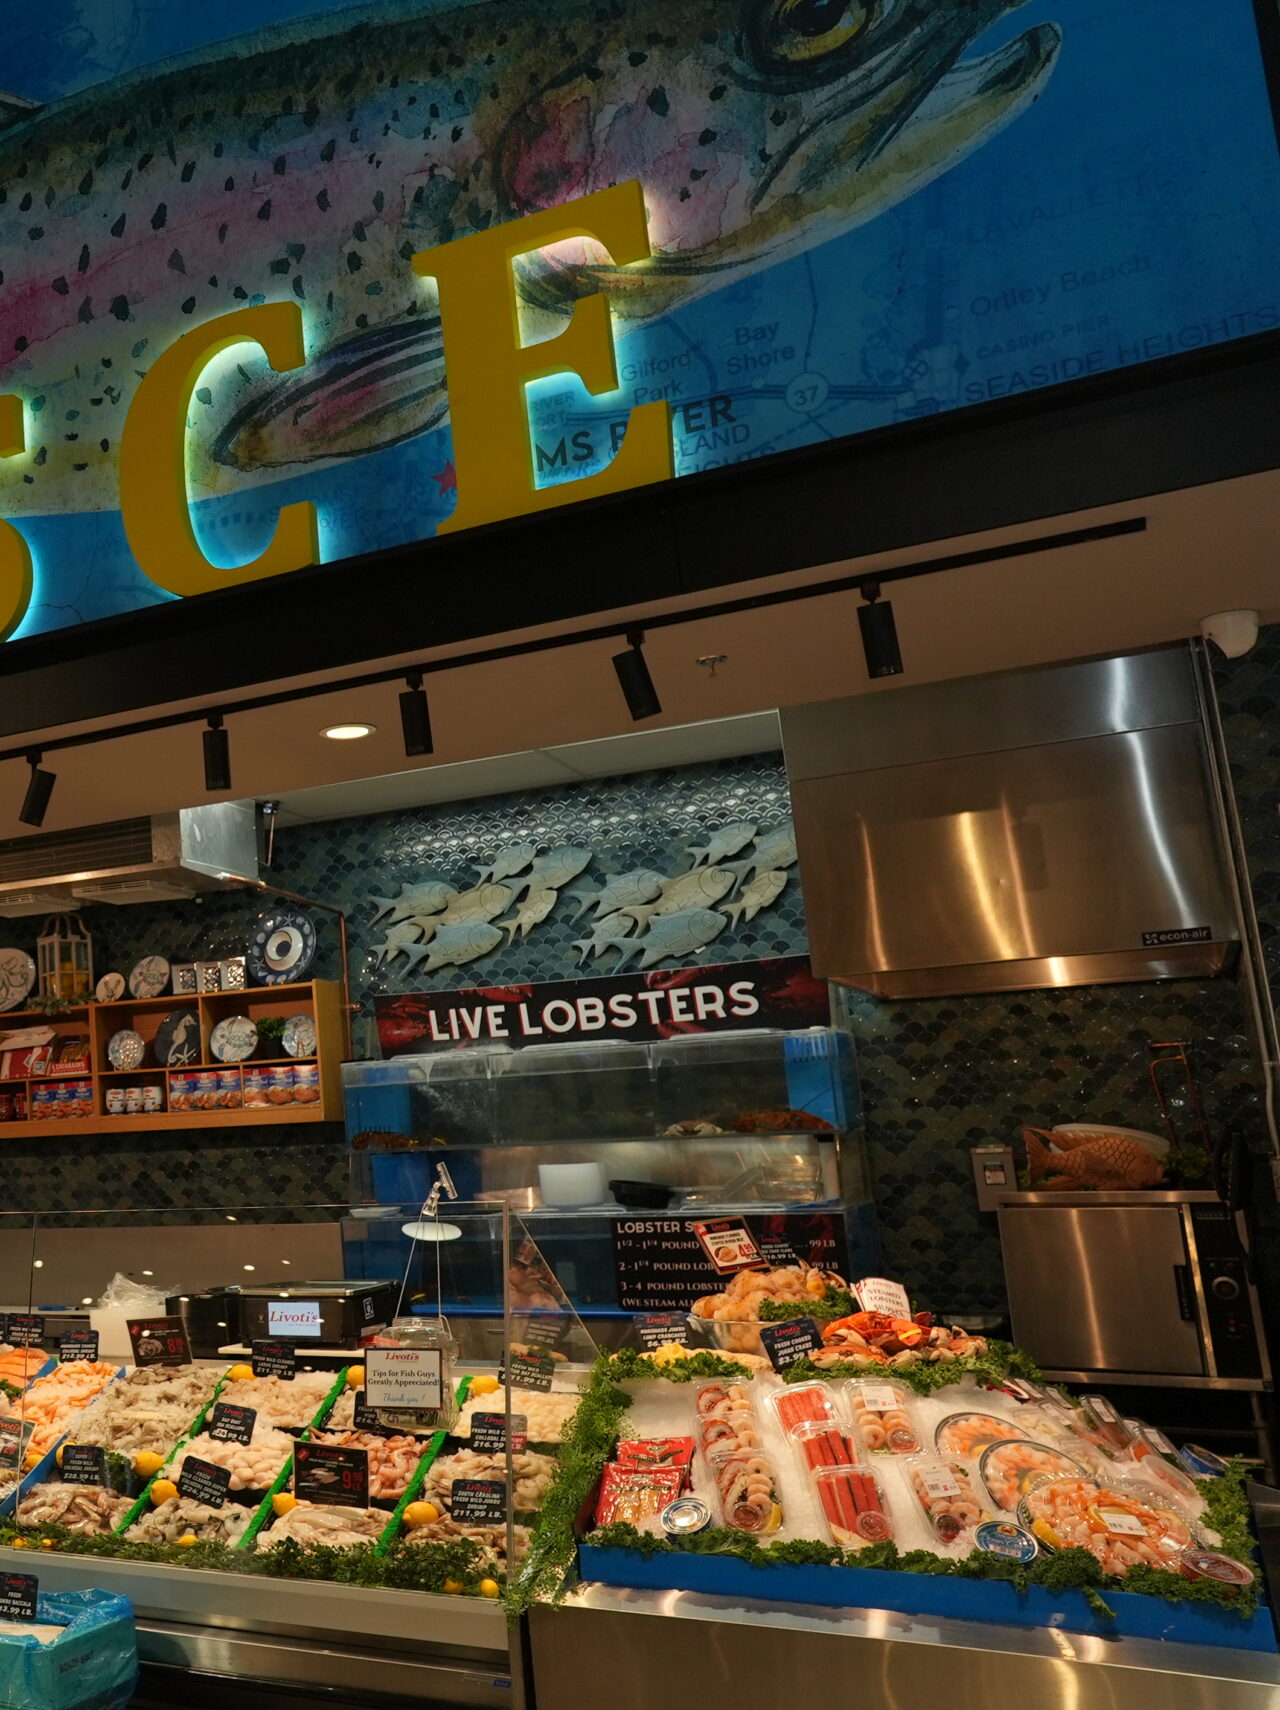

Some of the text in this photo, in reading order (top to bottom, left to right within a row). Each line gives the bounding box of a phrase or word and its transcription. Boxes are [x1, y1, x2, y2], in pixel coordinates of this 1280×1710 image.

[734, 320, 780, 347] Bay
[965, 304, 1278, 403] SEASIDE HEIGHTS
[621, 348, 691, 382] Gilford
[727, 345, 796, 377] Shore
[633, 382, 682, 408] Park
[796, 386, 819, 406] 37
[534, 430, 594, 472] MS
[428, 980, 761, 1043] LIVE LOBSTERS
[617, 1221, 681, 1234] LOBSTER
[661, 1241, 700, 1249] POUND
[823, 1239, 836, 1248] LB
[653, 1263, 691, 1271] POUND
[826, 1261, 839, 1269] LB
[647, 1282, 685, 1290] POUND
[687, 1282, 727, 1291] LOBSTE
[643, 1298, 678, 1307] STEAM
[270, 1311, 318, 1323] Livoti's
[385, 1352, 419, 1361] Livoti's
[373, 1370, 387, 1378] Tips
[416, 1370, 436, 1379] Guys
[367, 1378, 440, 1387] Greatly Appreciated!
[383, 1393, 405, 1402] Thank
[406, 1396, 419, 1405] you
[473, 1440, 505, 1449] $16.99
[452, 1509, 486, 1518] $11.99
